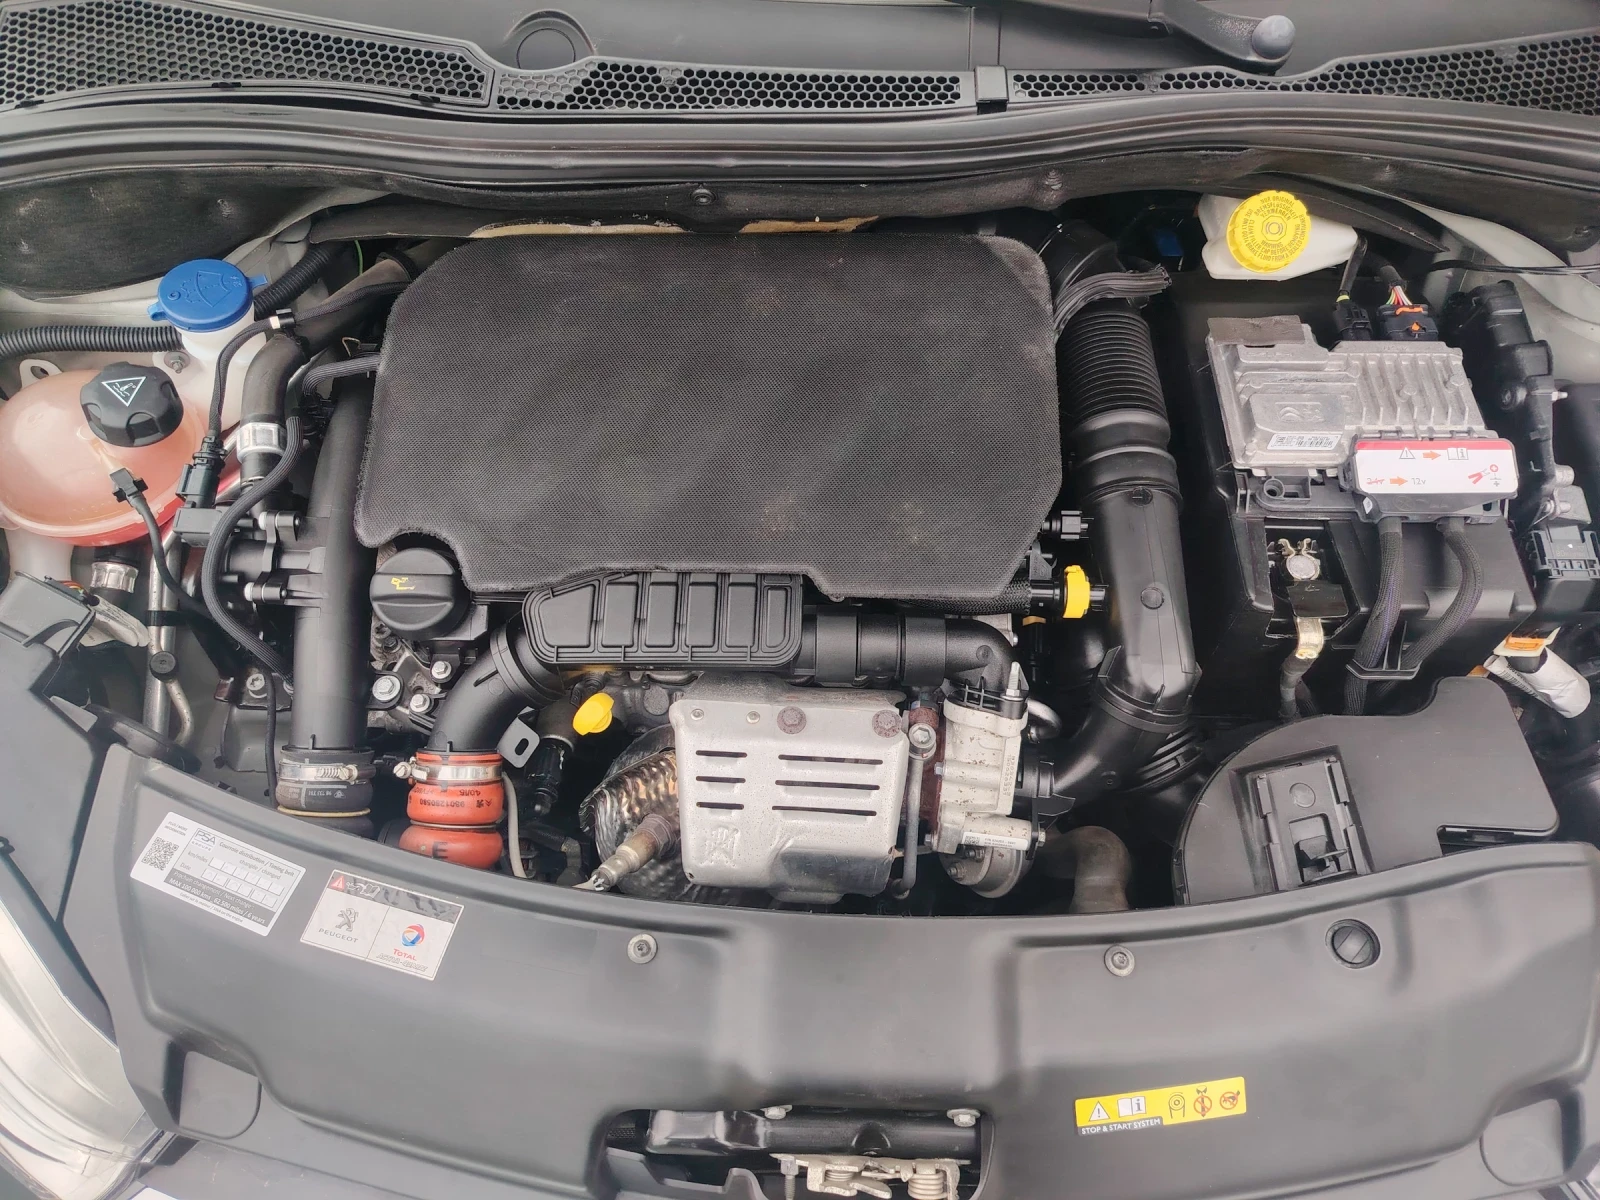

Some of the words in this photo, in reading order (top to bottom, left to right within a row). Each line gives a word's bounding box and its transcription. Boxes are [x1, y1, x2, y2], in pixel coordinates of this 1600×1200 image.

[1272, 195, 1295, 207] ORIGINAL
[1246, 241, 1259, 257] BRAKE
[1271, 254, 1285, 262] FROM
[1288, 240, 1303, 256] SEALED
[1411, 477, 1426, 485] 12v
[195, 830, 216, 845] PSA
[187, 851, 209, 863] km/miles
[219, 841, 239, 854] Courroie
[238, 849, 265, 865] distribution
[269, 862, 285, 874] Timing
[284, 868, 295, 877] belt
[180, 862, 191, 871] Date
[261, 869, 281, 880] changed
[173, 871, 193, 884] Prochain
[192, 879, 221, 896] changement
[224, 892, 236, 901] Next
[169, 877, 181, 887] MAX
[181, 883, 192, 892] 100
[230, 904, 244, 915] miles
[251, 913, 266, 924] years
[318, 928, 358, 943] PEUGEOT
[1081, 1126, 1101, 1135] STOP
[1109, 1122, 1131, 1131] START
[1133, 1117, 1161, 1129] SYSTEM
